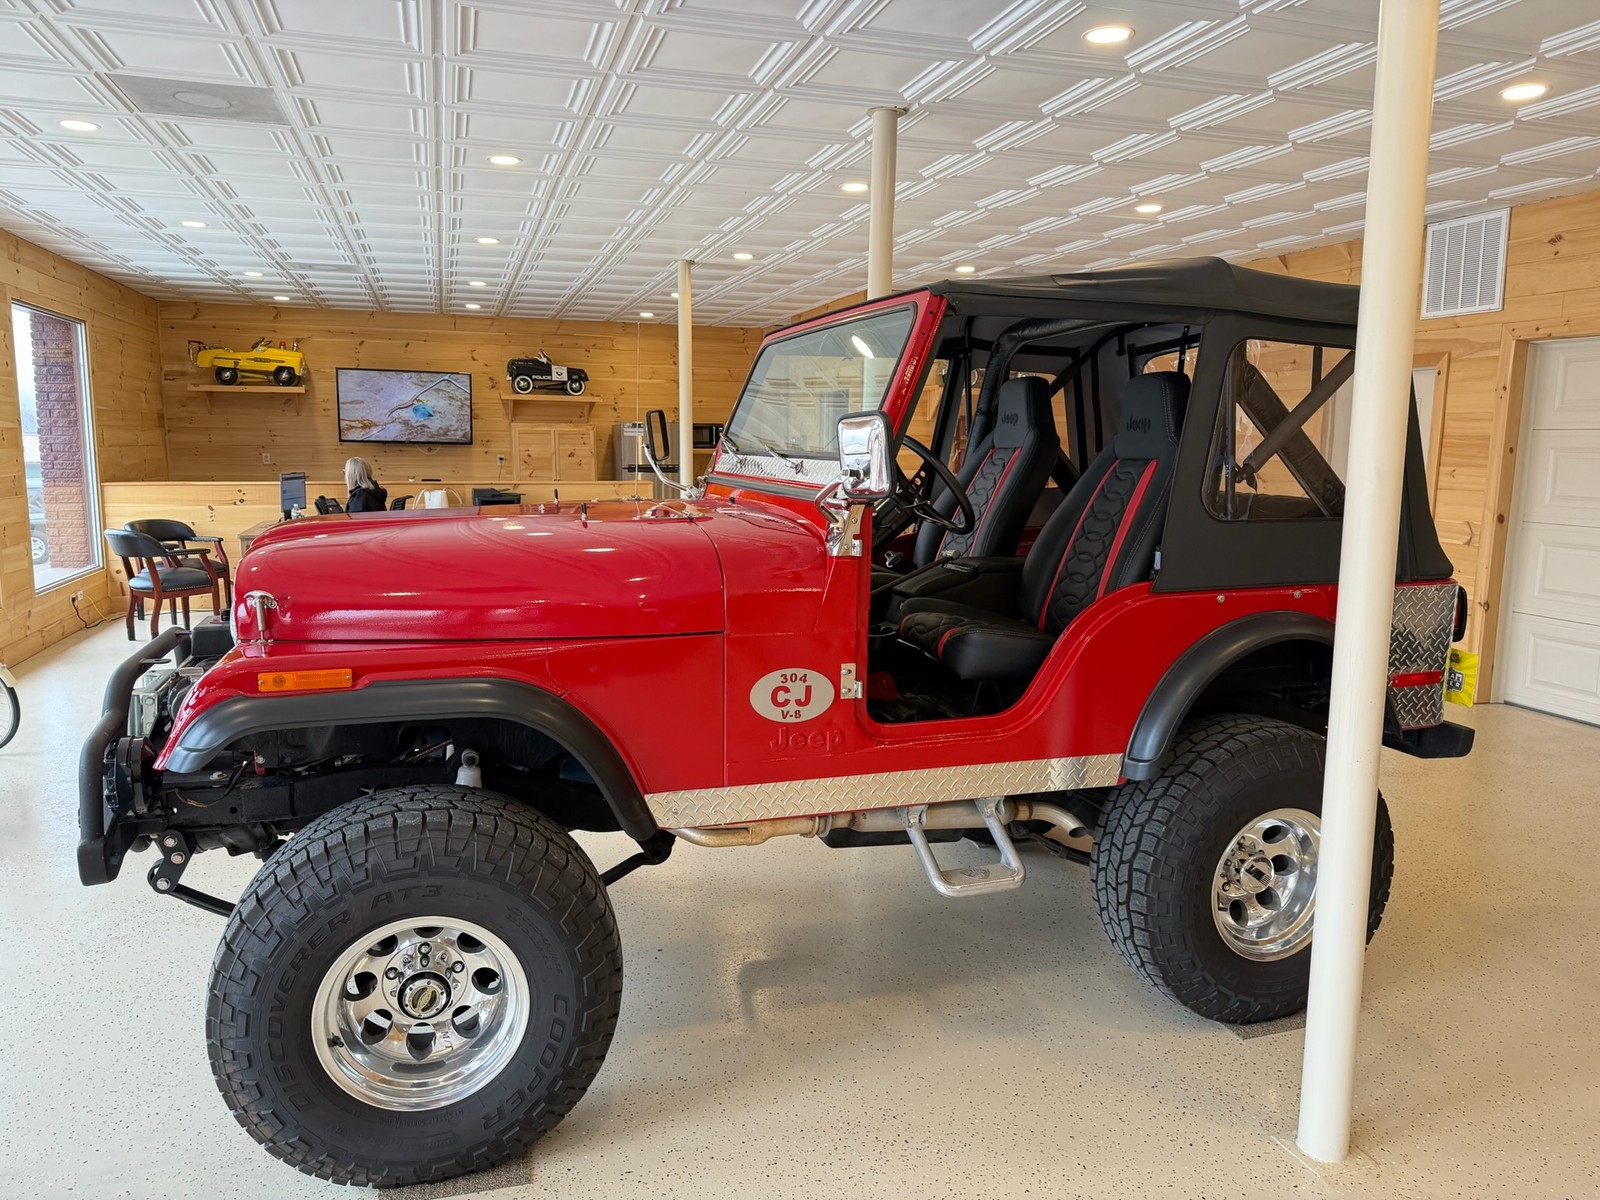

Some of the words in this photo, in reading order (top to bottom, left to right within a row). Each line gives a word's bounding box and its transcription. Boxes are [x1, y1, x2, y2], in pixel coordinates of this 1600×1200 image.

[1001, 410, 1019, 427] Jeep
[1126, 414, 1151, 434] Jeep
[780, 673, 808, 684] 304
[770, 685, 812, 708] CJ
[781, 710, 802, 719] V-8
[769, 727, 845, 752] Jeep
[268, 911, 350, 1112] DISCOVERER
[370, 884, 443, 911] AT3
[482, 994, 569, 1130] COOPER
